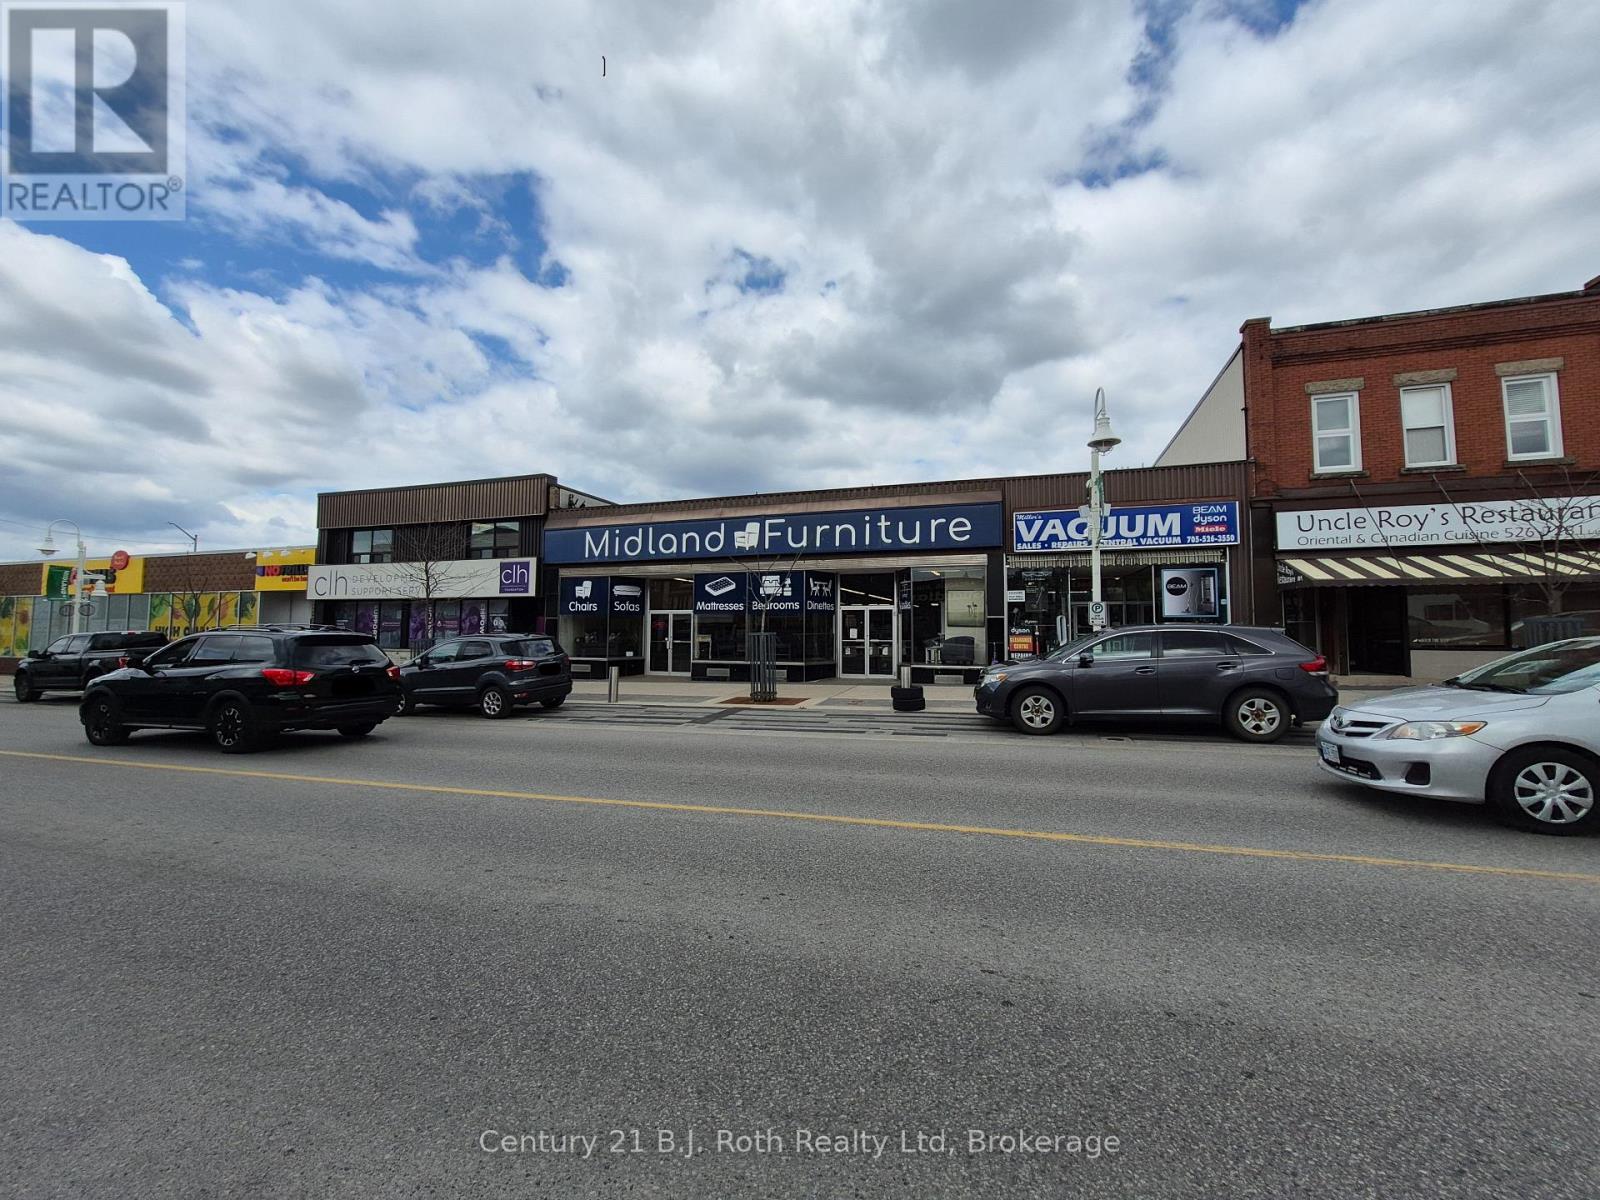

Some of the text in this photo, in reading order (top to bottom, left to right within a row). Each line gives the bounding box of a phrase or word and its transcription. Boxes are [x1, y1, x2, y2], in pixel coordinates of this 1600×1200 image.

[1193, 505, 1227, 514] BEAM
[1194, 514, 1227, 525] dyson
[1297, 512, 1367, 532] Uncle
[1378, 508, 1449, 531] Roy's
[1016, 513, 1181, 541] VACUUM
[585, 514, 972, 558] Midland Furniture
[1297, 535, 1351, 546] Oriental
[1356, 533, 1366, 544] &
[1371, 531, 1439, 543] Canadian
[1444, 530, 1500, 541] Cuisine
[1501, 527, 1535, 538] 526
[1017, 542, 1042, 550] SALES
[1051, 541, 1089, 550] REPAIRS
[1140, 535, 1182, 545] VACUUM
[501, 564, 528, 584] clh
[315, 569, 348, 596] clh
[352, 586, 392, 596] SUPPORT
[568, 601, 640, 612] Chairs Sofas
[696, 601, 744, 611] Mattresses
[752, 601, 800, 611] Bedrooms
[806, 600, 835, 611] Dinettes
[1010, 627, 1031, 635] dyson
